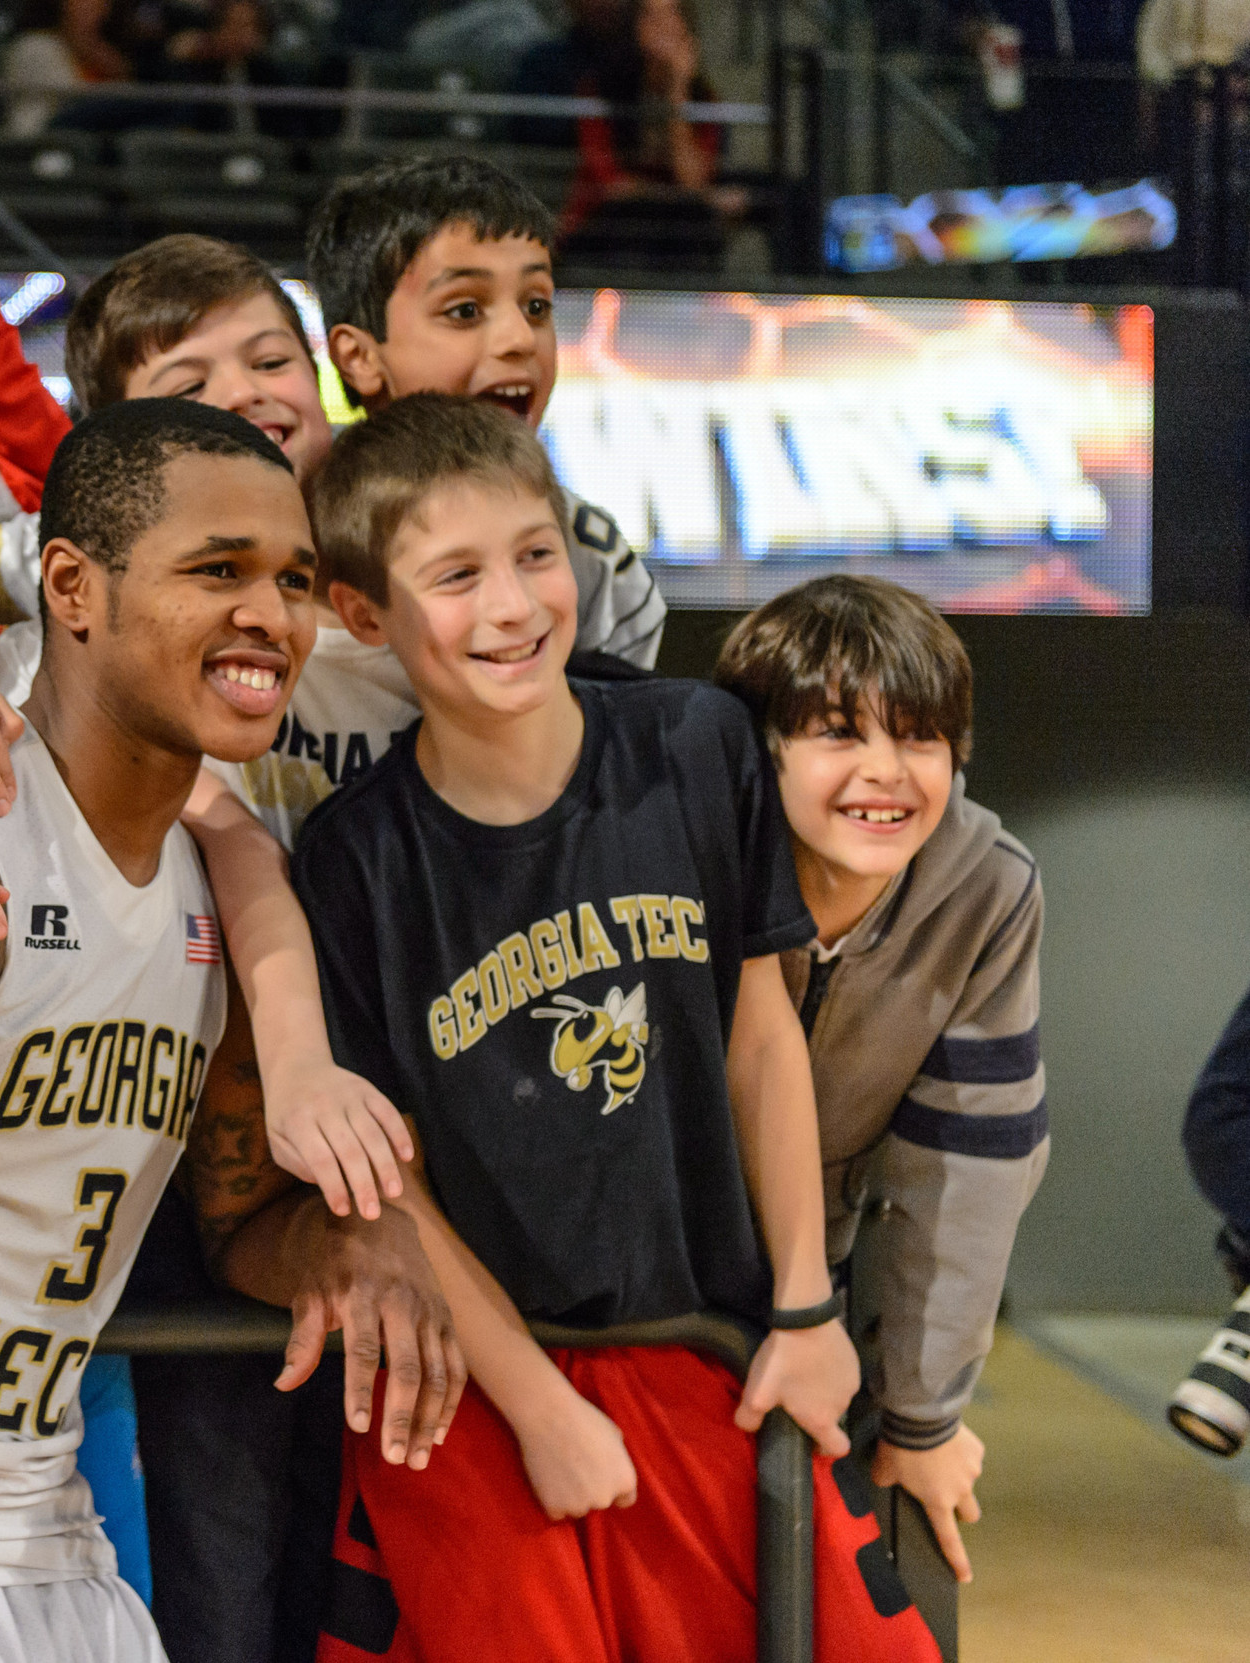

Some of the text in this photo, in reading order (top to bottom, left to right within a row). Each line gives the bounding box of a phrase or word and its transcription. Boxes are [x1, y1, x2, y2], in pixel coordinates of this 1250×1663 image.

[25, 937, 81, 950] RUSSELL
[31, 905, 69, 936] R
[428, 894, 711, 1060] GEORGIA TEC
[35, 1167, 129, 1306] 3
